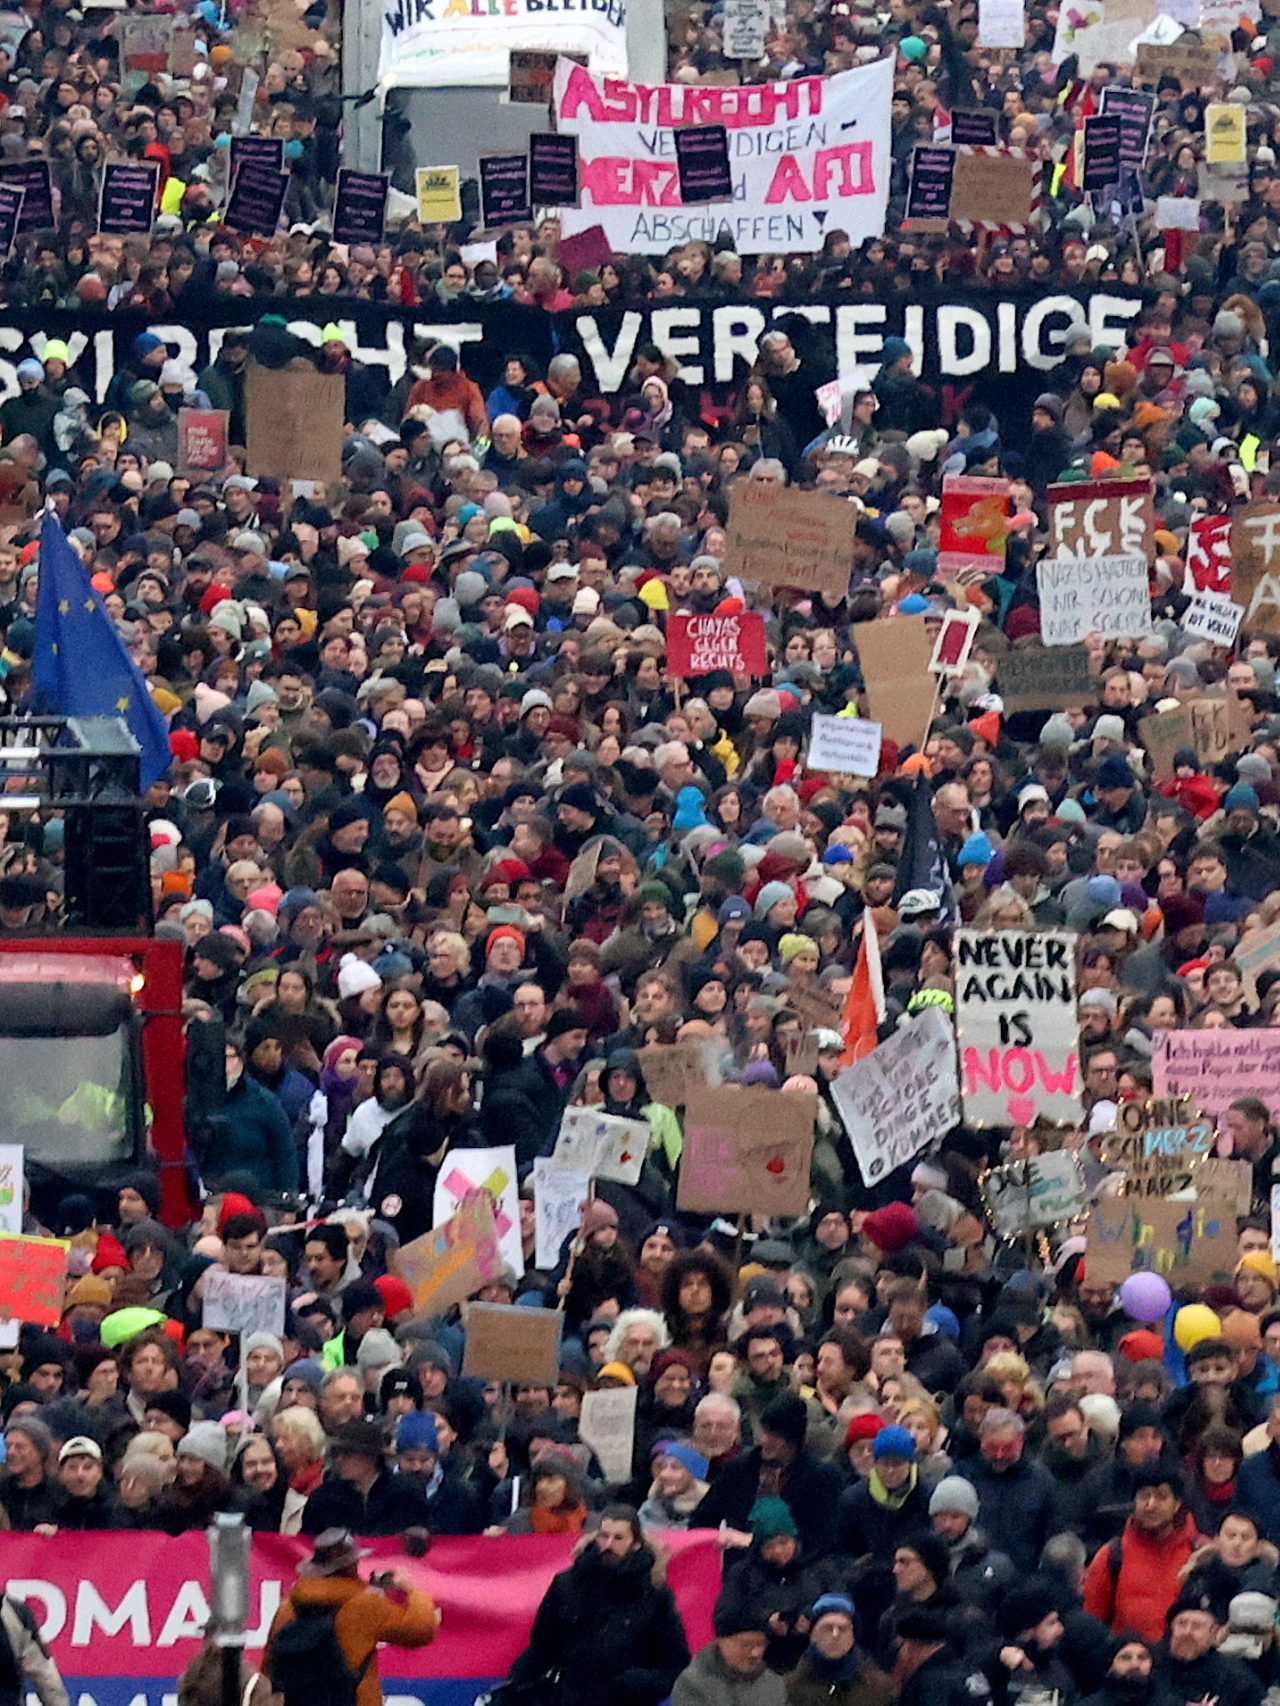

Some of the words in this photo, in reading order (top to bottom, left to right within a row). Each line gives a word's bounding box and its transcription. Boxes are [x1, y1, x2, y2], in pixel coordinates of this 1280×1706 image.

[560, 66, 828, 128] ASYLRECHT
[1053, 496, 1146, 542] FCK
[690, 653, 746, 671] RECHTS
[958, 935, 1068, 969] NEVER
[962, 972, 1073, 1003] AGAIN
[998, 1009, 1034, 1048] IS
[963, 1046, 1078, 1096] NOW
